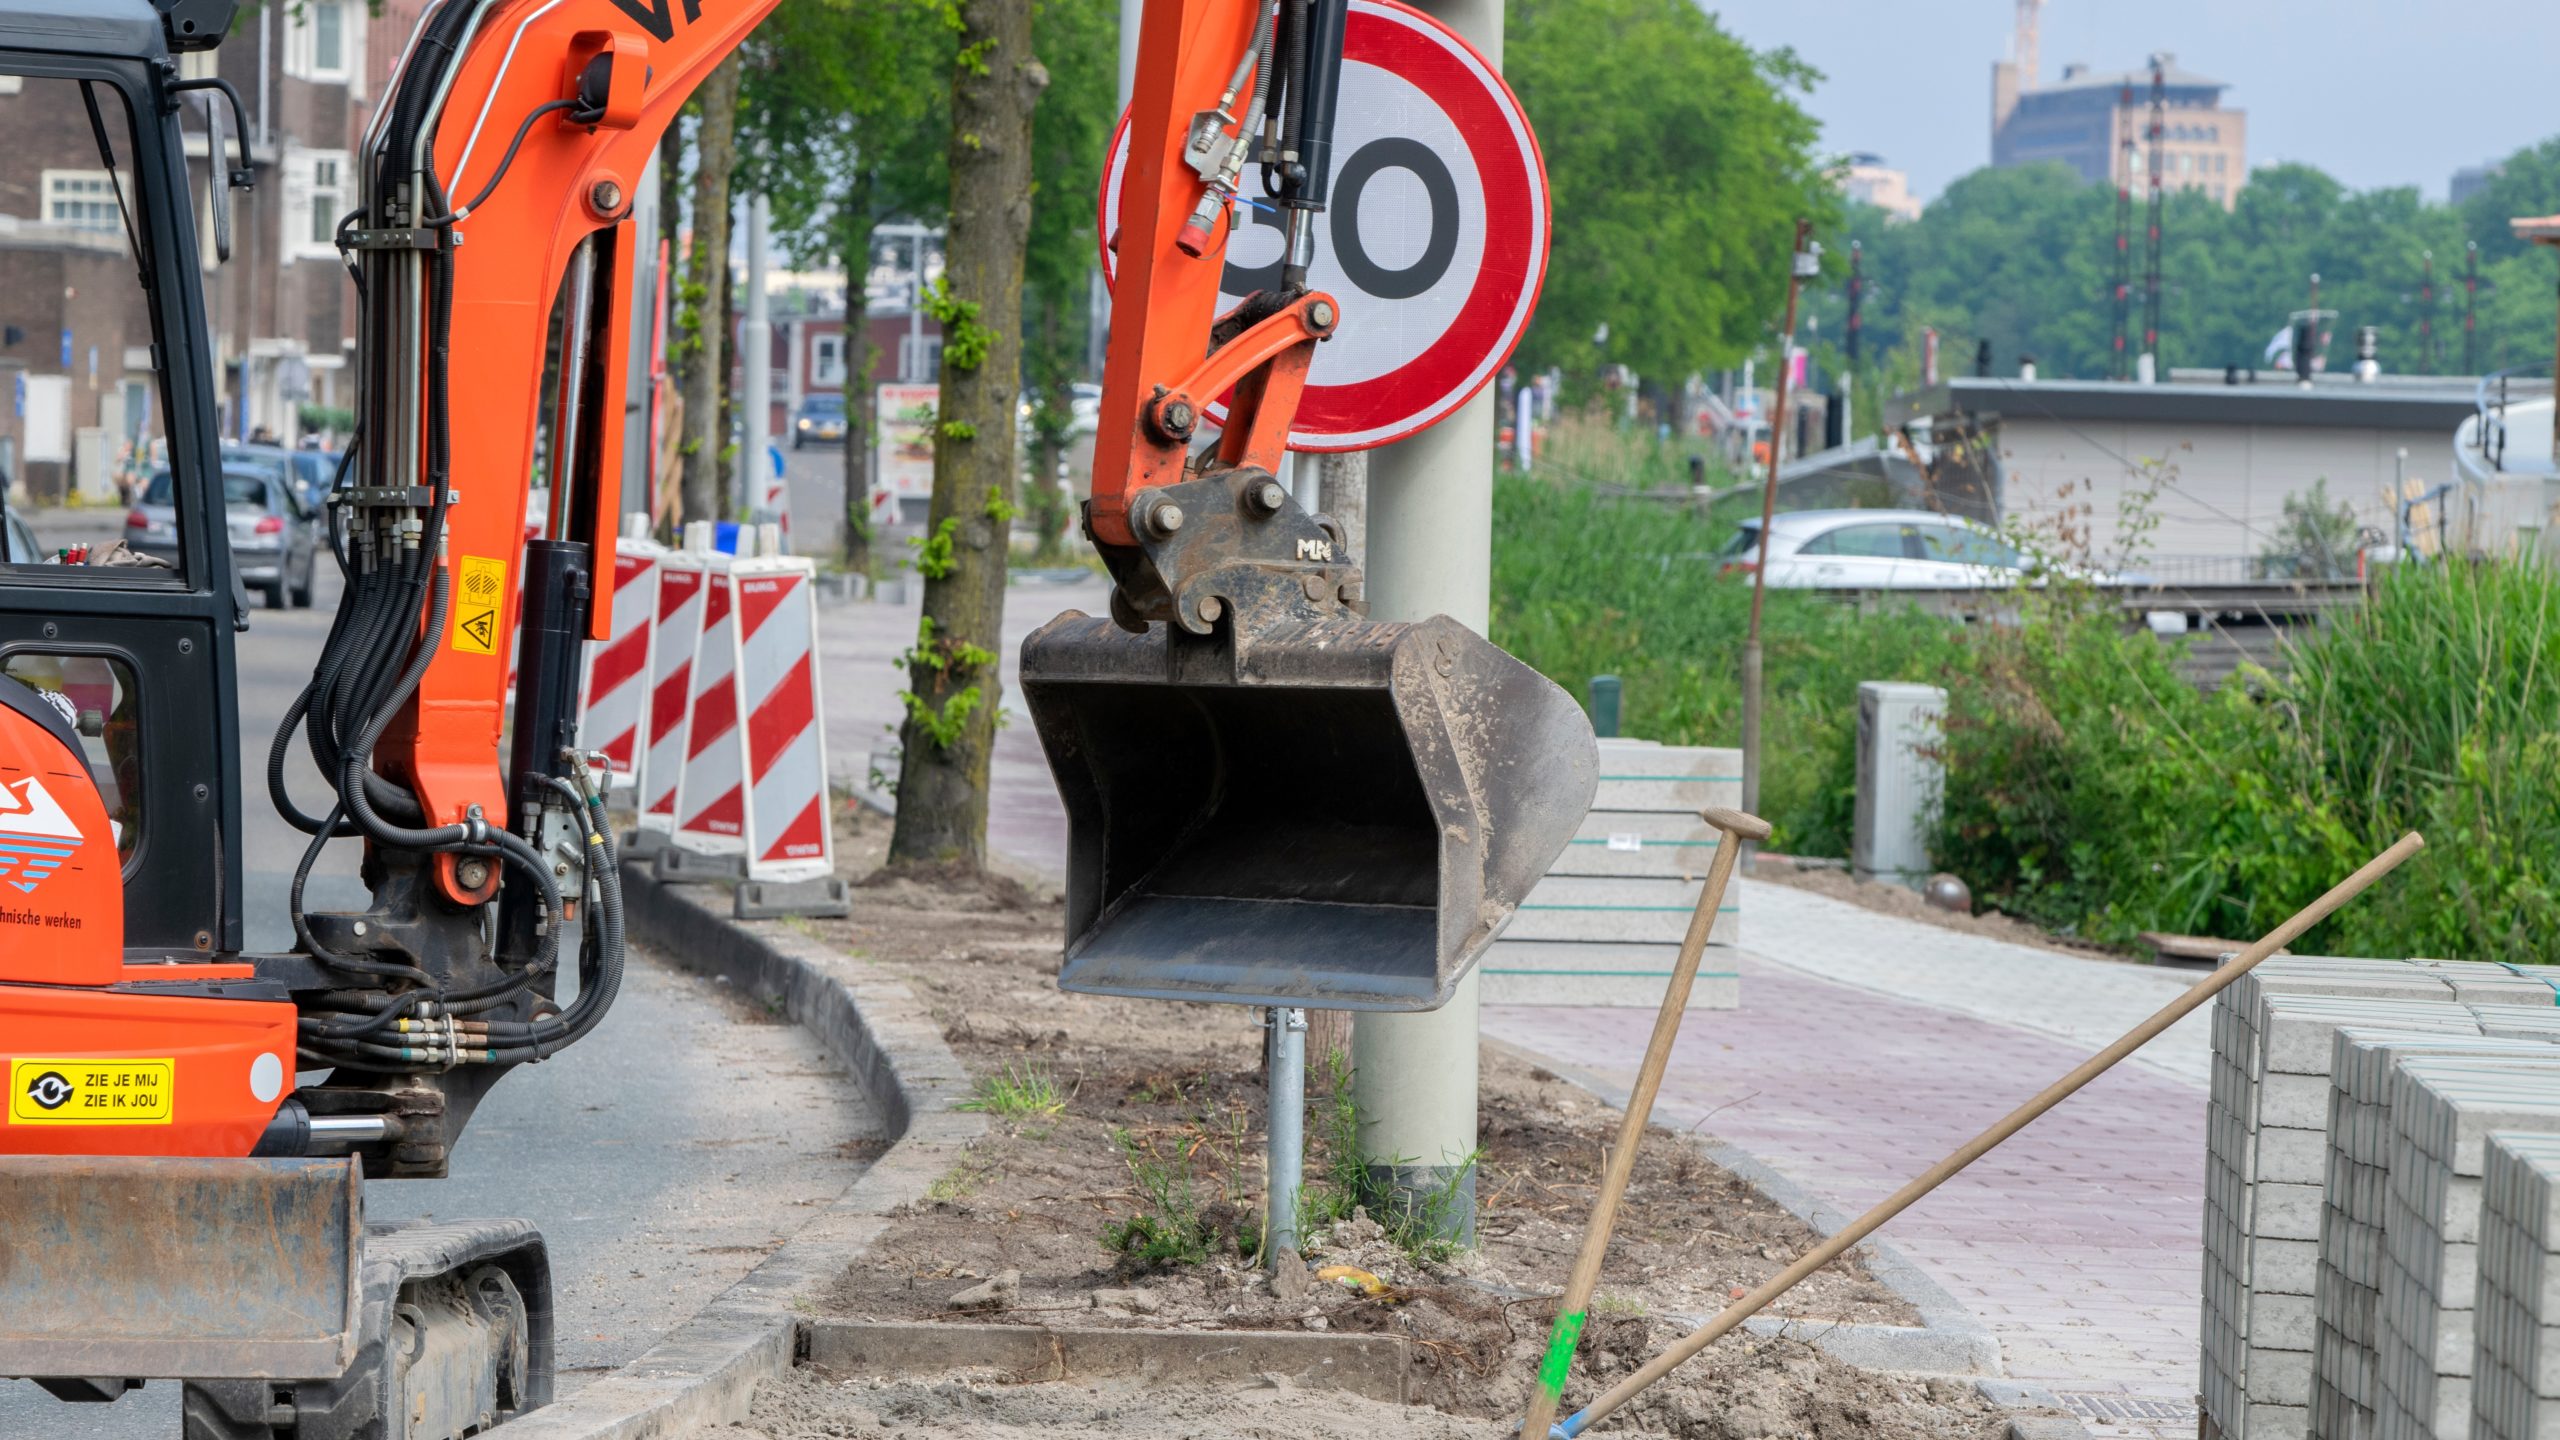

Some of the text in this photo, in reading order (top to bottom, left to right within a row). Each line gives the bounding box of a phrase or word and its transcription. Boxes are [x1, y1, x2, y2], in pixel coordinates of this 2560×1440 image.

[44, 911, 82, 929] werken
[85, 1074, 158, 1087] ZIE JE MIJ
[84, 1094, 158, 1107] ZIE IK JOU
